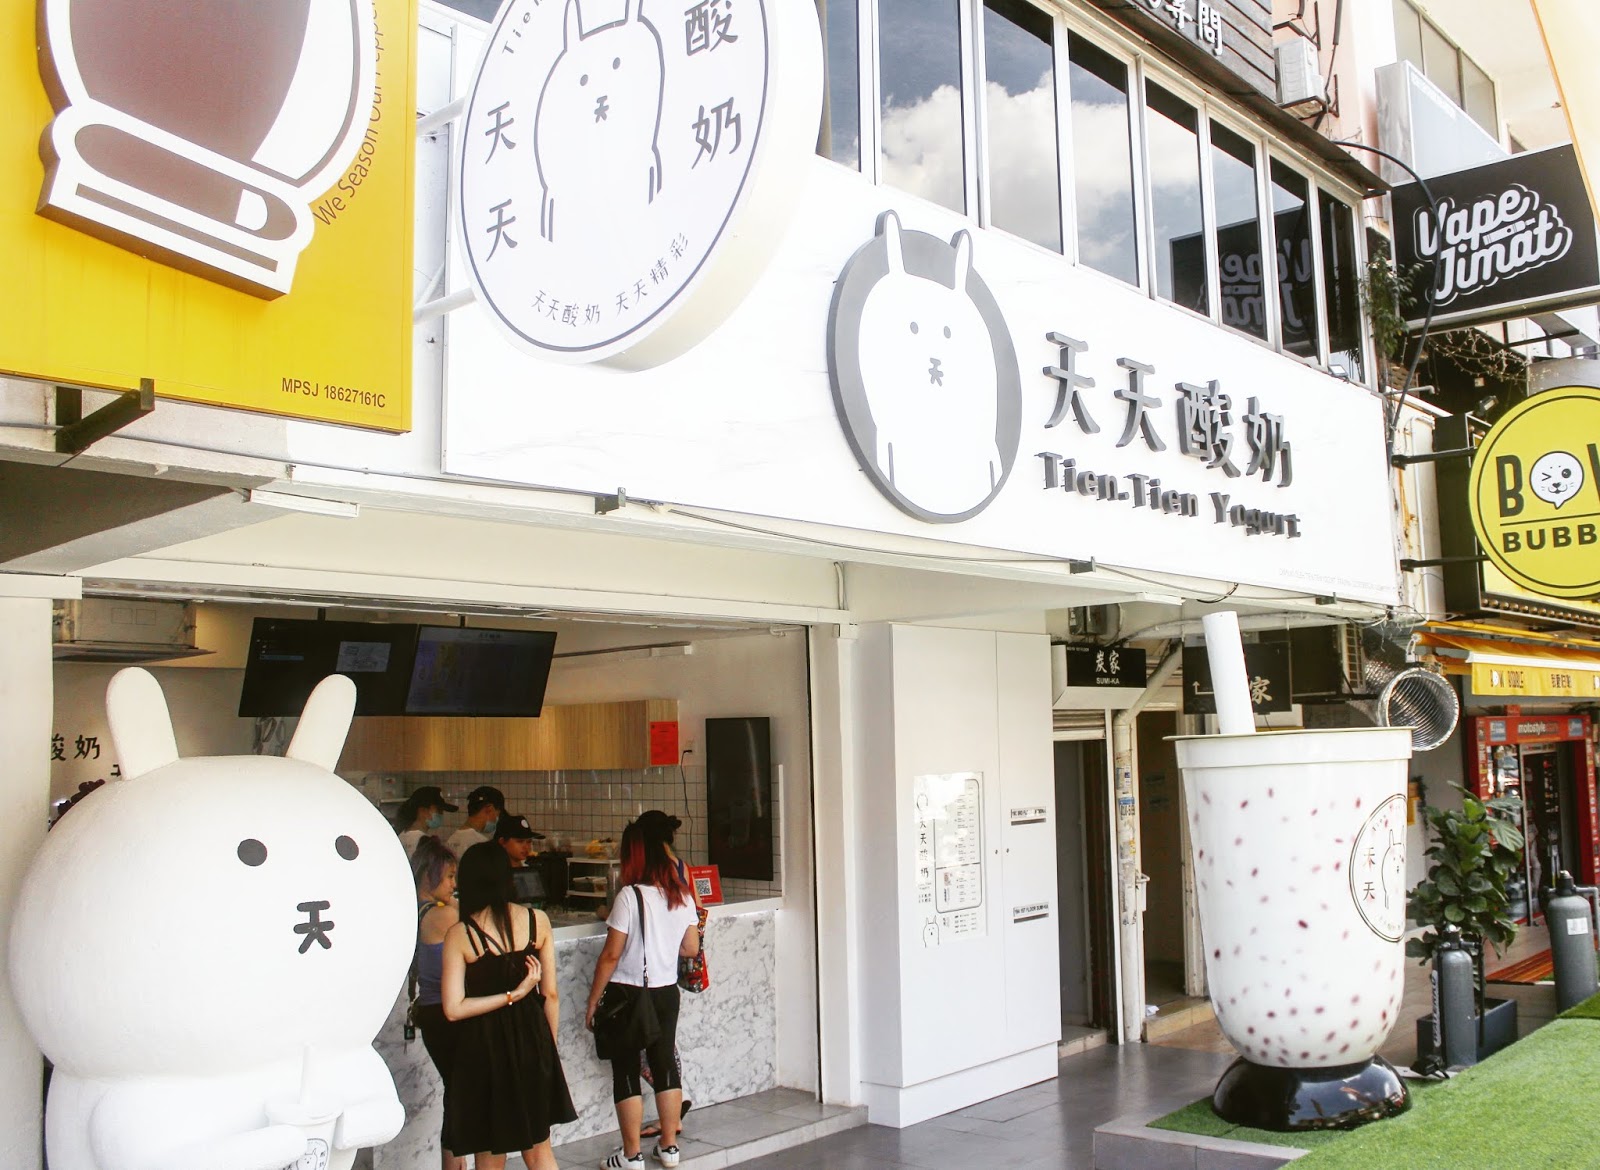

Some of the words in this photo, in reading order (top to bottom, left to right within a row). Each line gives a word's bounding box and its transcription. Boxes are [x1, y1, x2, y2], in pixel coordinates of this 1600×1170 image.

[502, 0, 540, 54] Tie
[313, 199, 346, 226] We
[337, 128, 379, 198] Season
[485, 100, 518, 263] 天天
[1418, 189, 1531, 256] Vape
[1435, 210, 1563, 300] Jimat
[531, 289, 601, 328] 天天酸奶
[615, 232, 688, 318] 天天精彩
[281, 377, 319, 398] MPSJ
[323, 384, 386, 408] 18627161C
[1042, 331, 1294, 489] 天天酸奶
[1208, 491, 1302, 540] Yogurt
[1096, 677, 1121, 685] SUMI-KA
